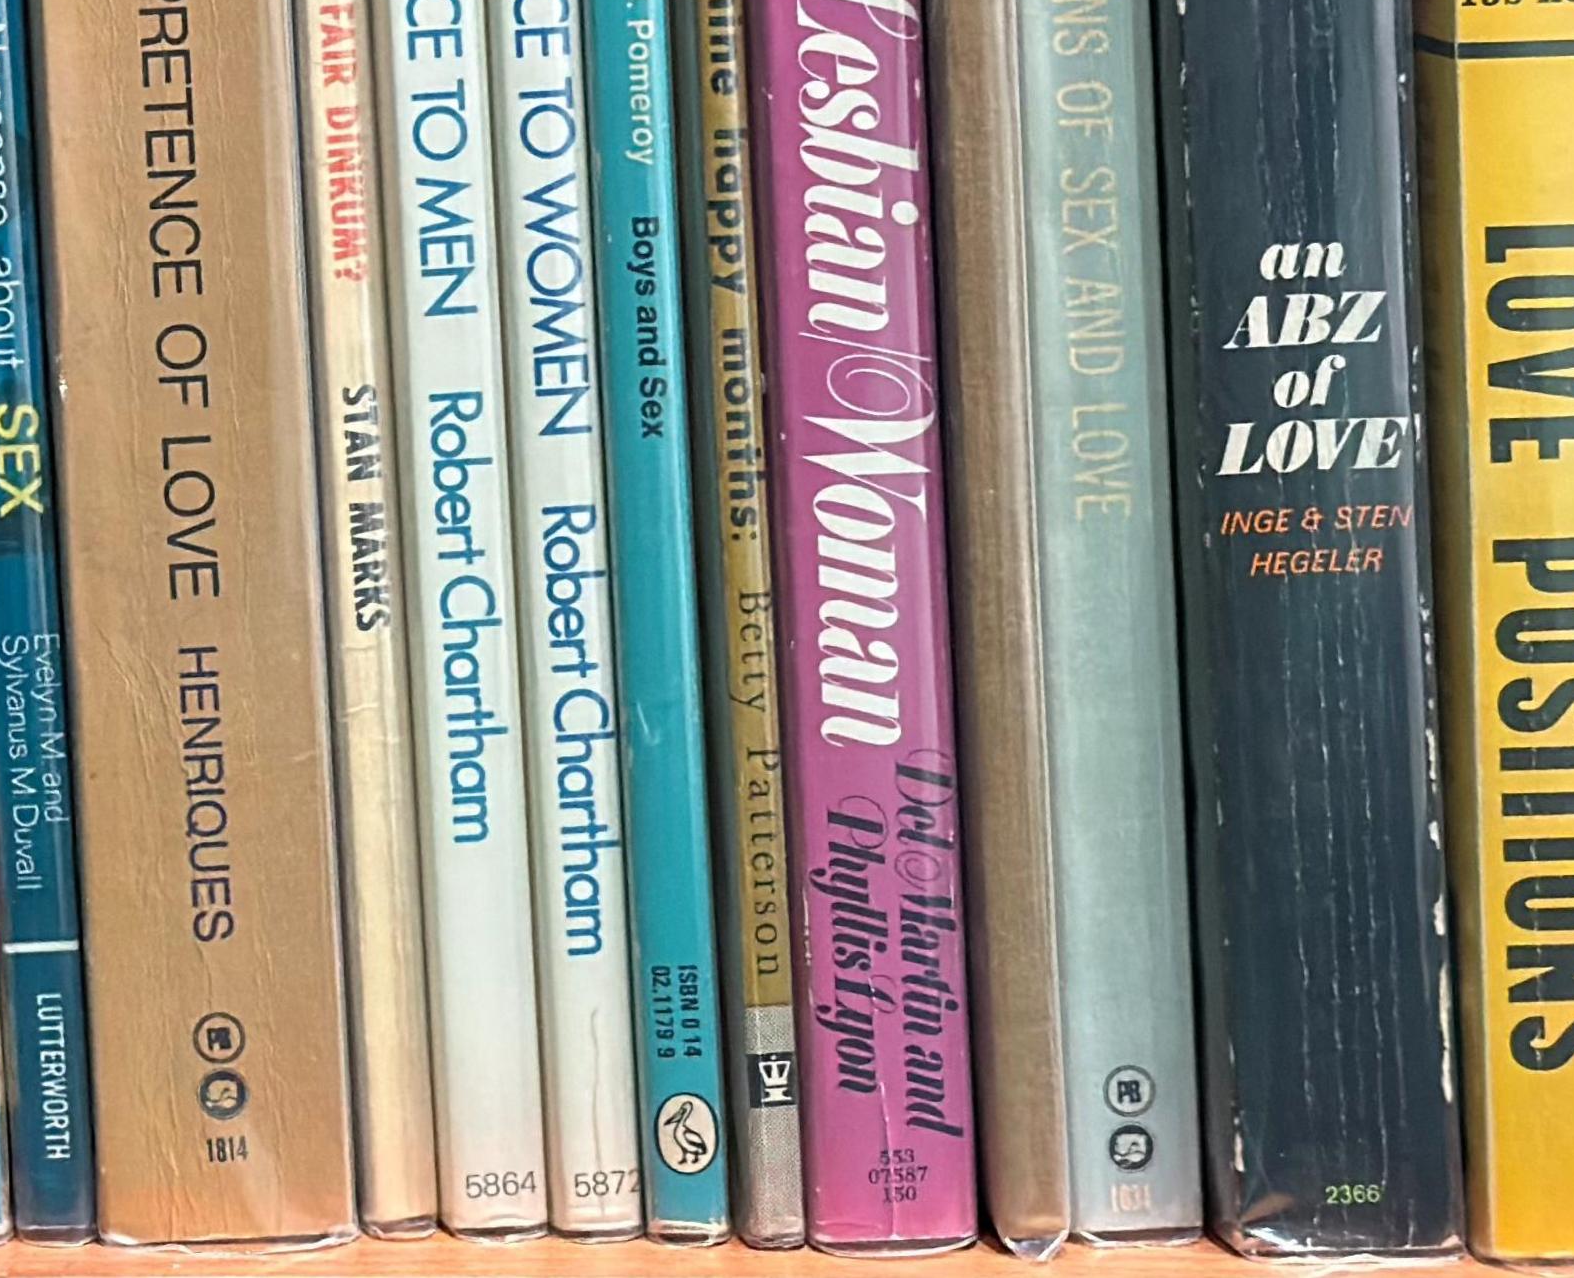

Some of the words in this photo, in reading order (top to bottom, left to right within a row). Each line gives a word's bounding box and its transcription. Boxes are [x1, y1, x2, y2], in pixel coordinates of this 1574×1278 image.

[408, 80, 468, 163] TO
[415, 176, 479, 317] MEN
[1259, 238, 1348, 282] an
[1223, 290, 1387, 351] ABZ
[155, 325, 208, 409] OF
[1272, 354, 1345, 409] of
[1216, 416, 1411, 477] LOVE
[163, 435, 219, 601] LOVE
[1221, 508, 1290, 535] INGE
[1302, 508, 1322, 531] &
[1335, 503, 1411, 530] STEN
[543, 503, 597, 681] Robert
[1250, 547, 1384, 575] HEGELER
[731, 590, 770, 716] Betty
[178, 644, 234, 943] HENRIQUES
[553, 688, 620, 958] Chartham
[748, 748, 782, 977] Patterson
[37, 993, 70, 1160] LUTTERWORTH
[206, 1136, 248, 1163] 1814
[465, 1170, 537, 1198] 5864
[1326, 1184, 1380, 1203] 2366
